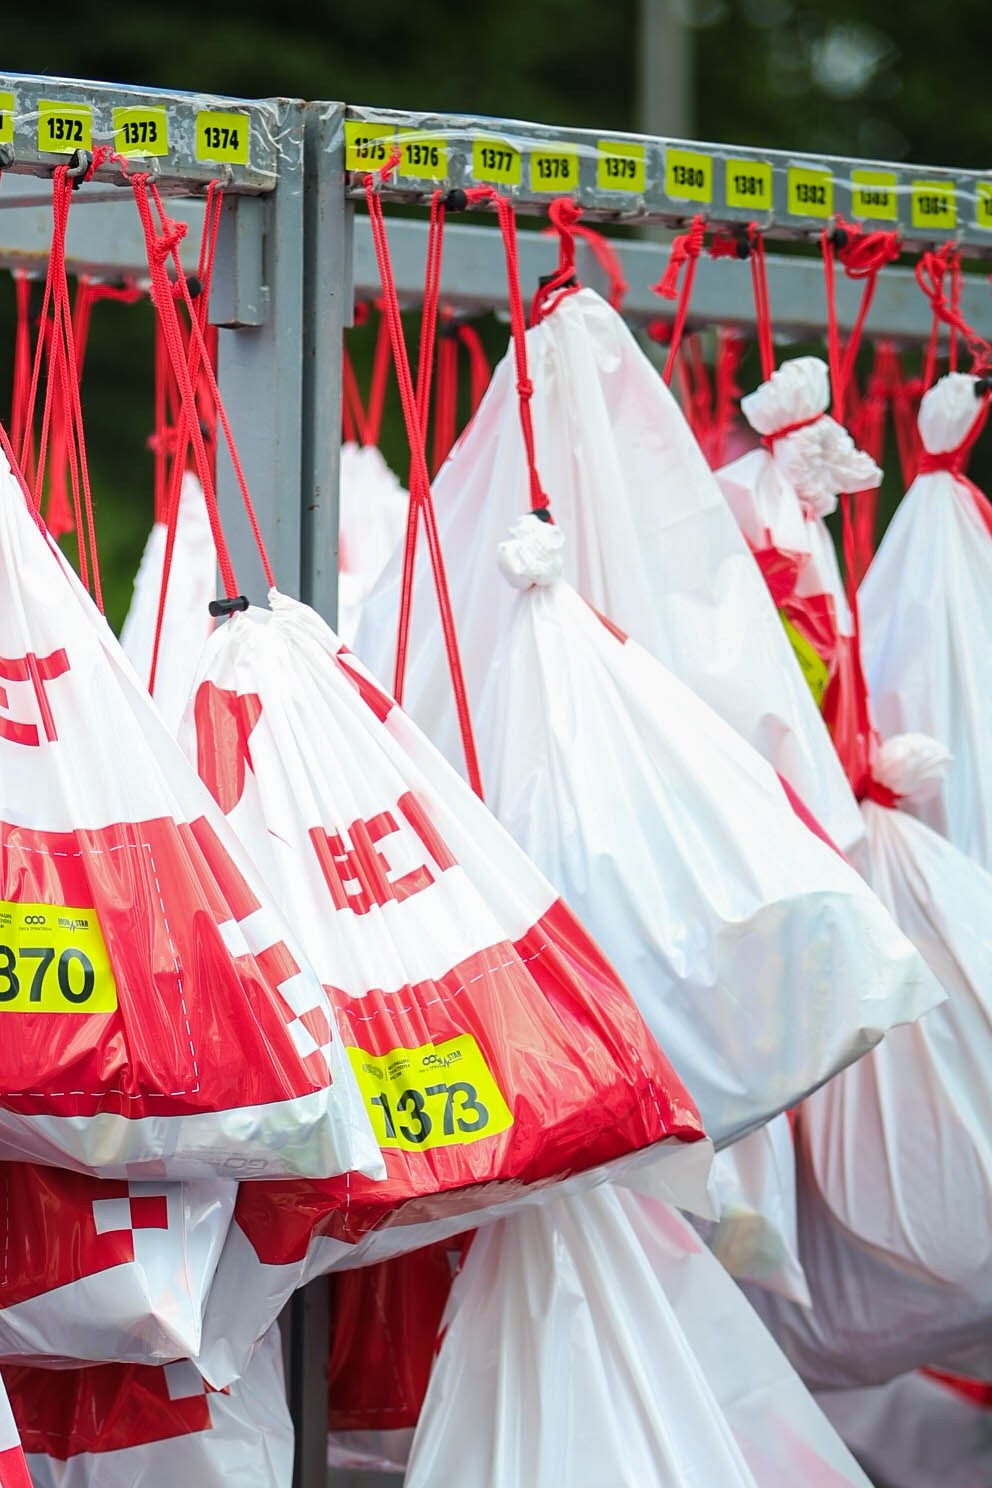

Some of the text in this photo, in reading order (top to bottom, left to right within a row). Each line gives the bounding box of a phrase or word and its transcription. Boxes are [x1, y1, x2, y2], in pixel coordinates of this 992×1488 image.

[47, 117, 83, 142] 1372
[123, 121, 158, 144] 1373
[204, 127, 239, 150] 1374
[355, 137, 386, 160] 1375
[406, 144, 439, 167] 1376
[481, 148, 513, 172] 1377
[537, 158, 570, 179] 1378
[605, 158, 636, 179] 1379
[672, 165, 704, 188] 1380
[733, 176, 764, 197] 1381
[795, 183, 826, 205] 1382
[371, 1081, 489, 1144] 1373
